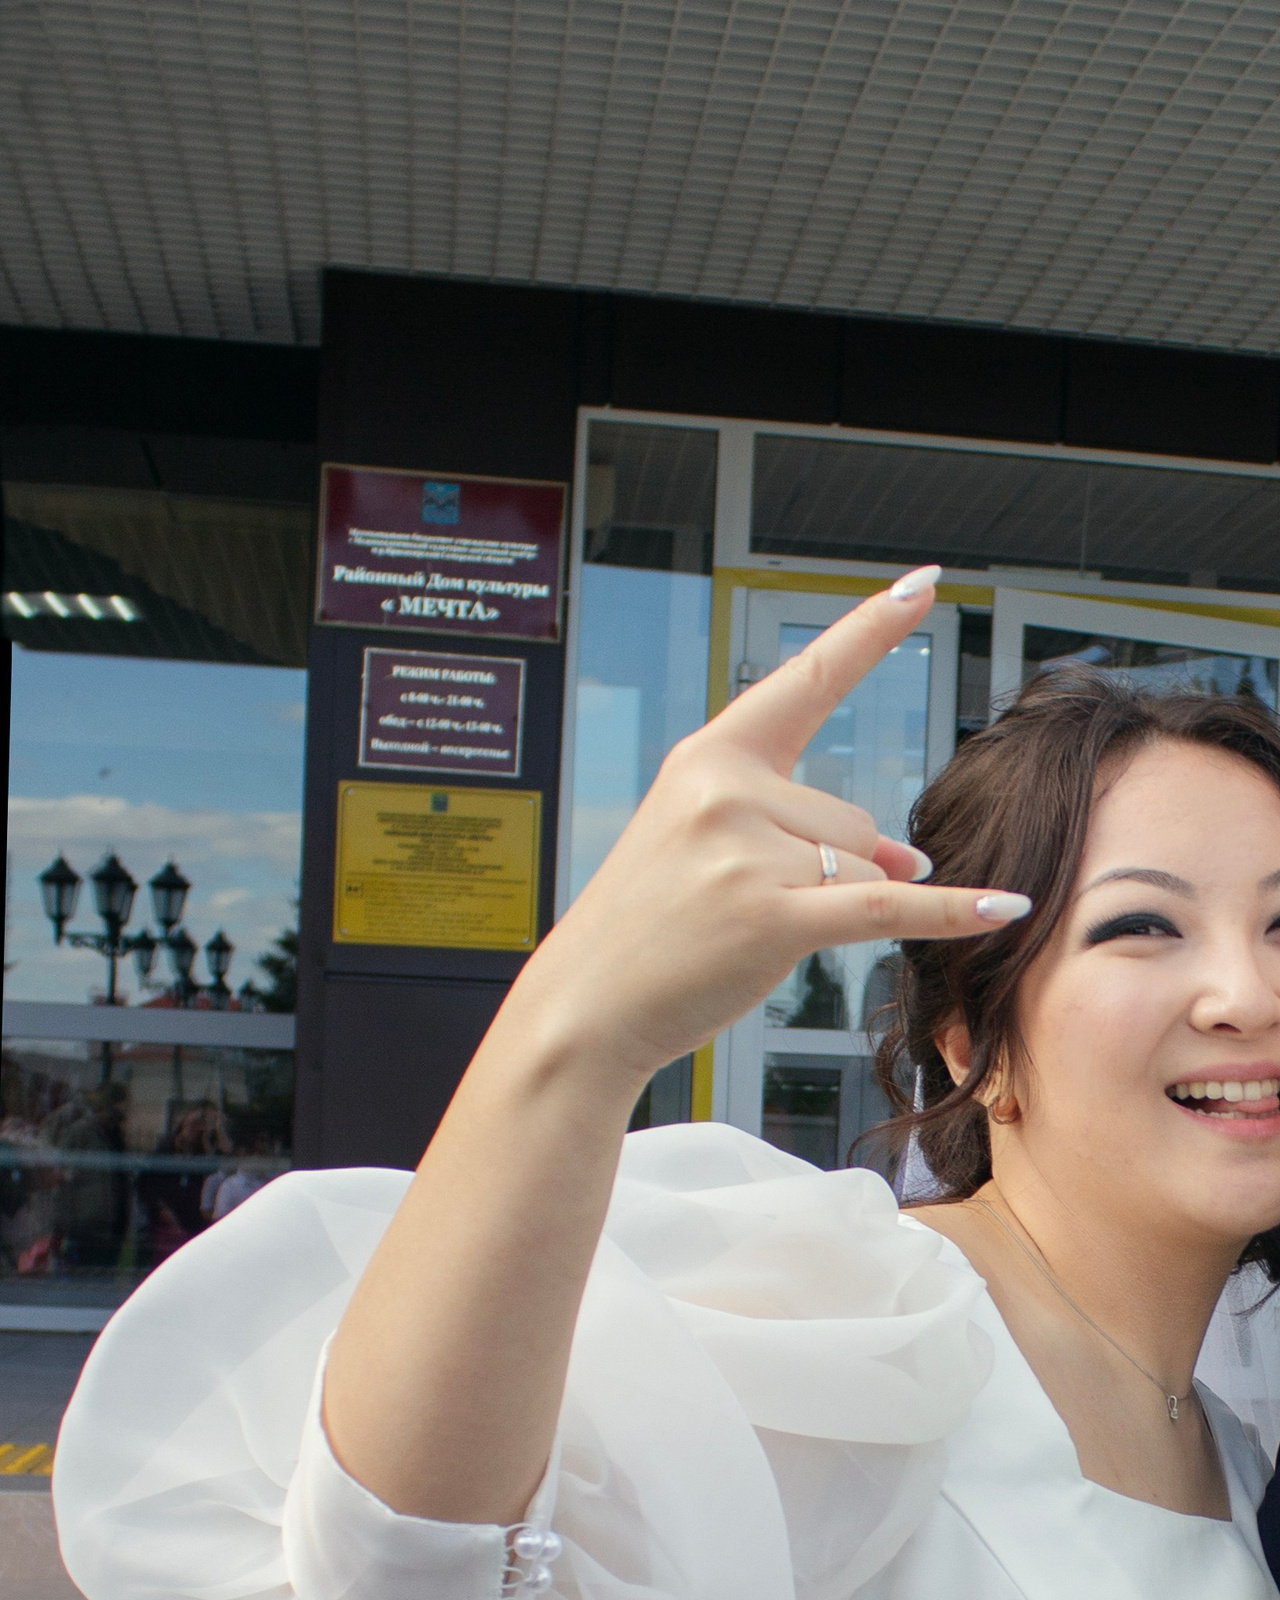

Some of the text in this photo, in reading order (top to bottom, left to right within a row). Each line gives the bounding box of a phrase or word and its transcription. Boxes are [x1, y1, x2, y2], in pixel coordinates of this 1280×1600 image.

[332, 565, 550, 600] Районный Дом культуры
[392, 665, 440, 681] РЕЖИМ
